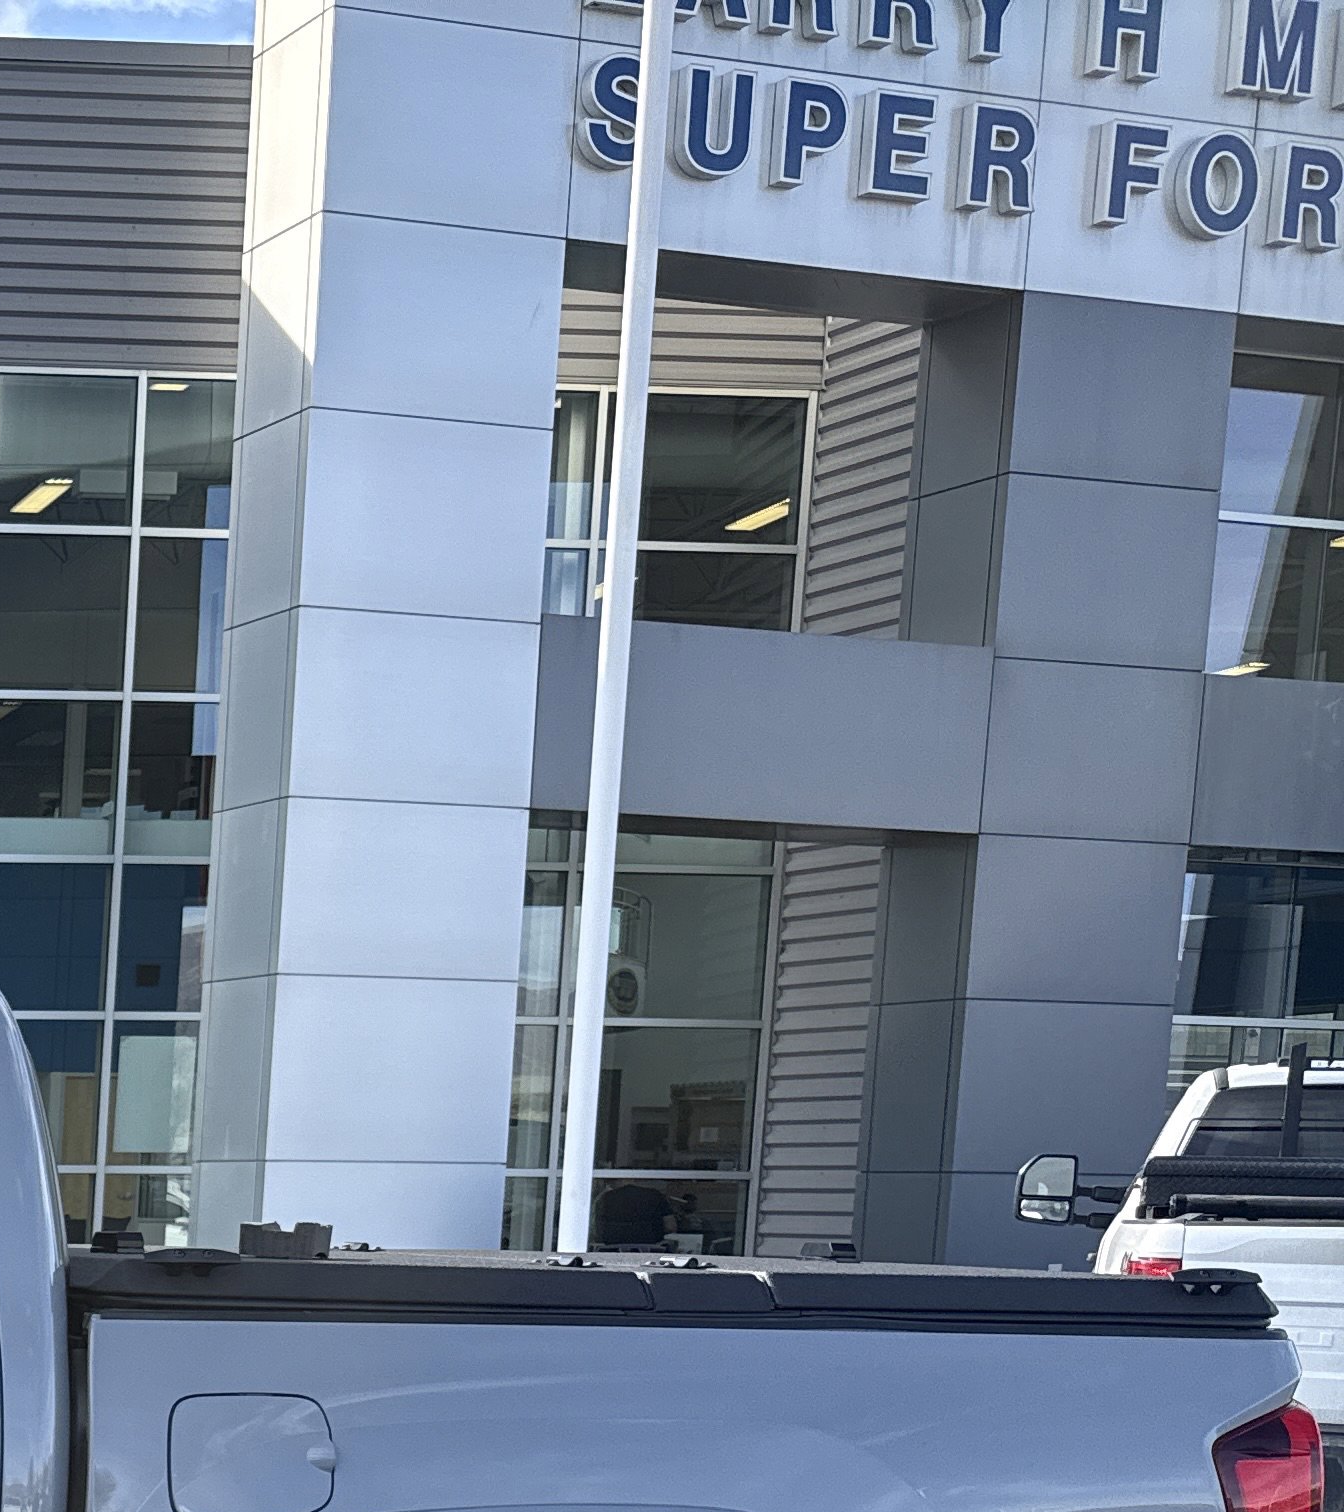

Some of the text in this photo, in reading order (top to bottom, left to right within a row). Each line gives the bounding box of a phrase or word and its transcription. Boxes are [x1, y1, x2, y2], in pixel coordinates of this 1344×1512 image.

[1084, 0, 1164, 83] H
[1223, 0, 1344, 107] M
[577, 53, 1344, 253] SUPER FOR
